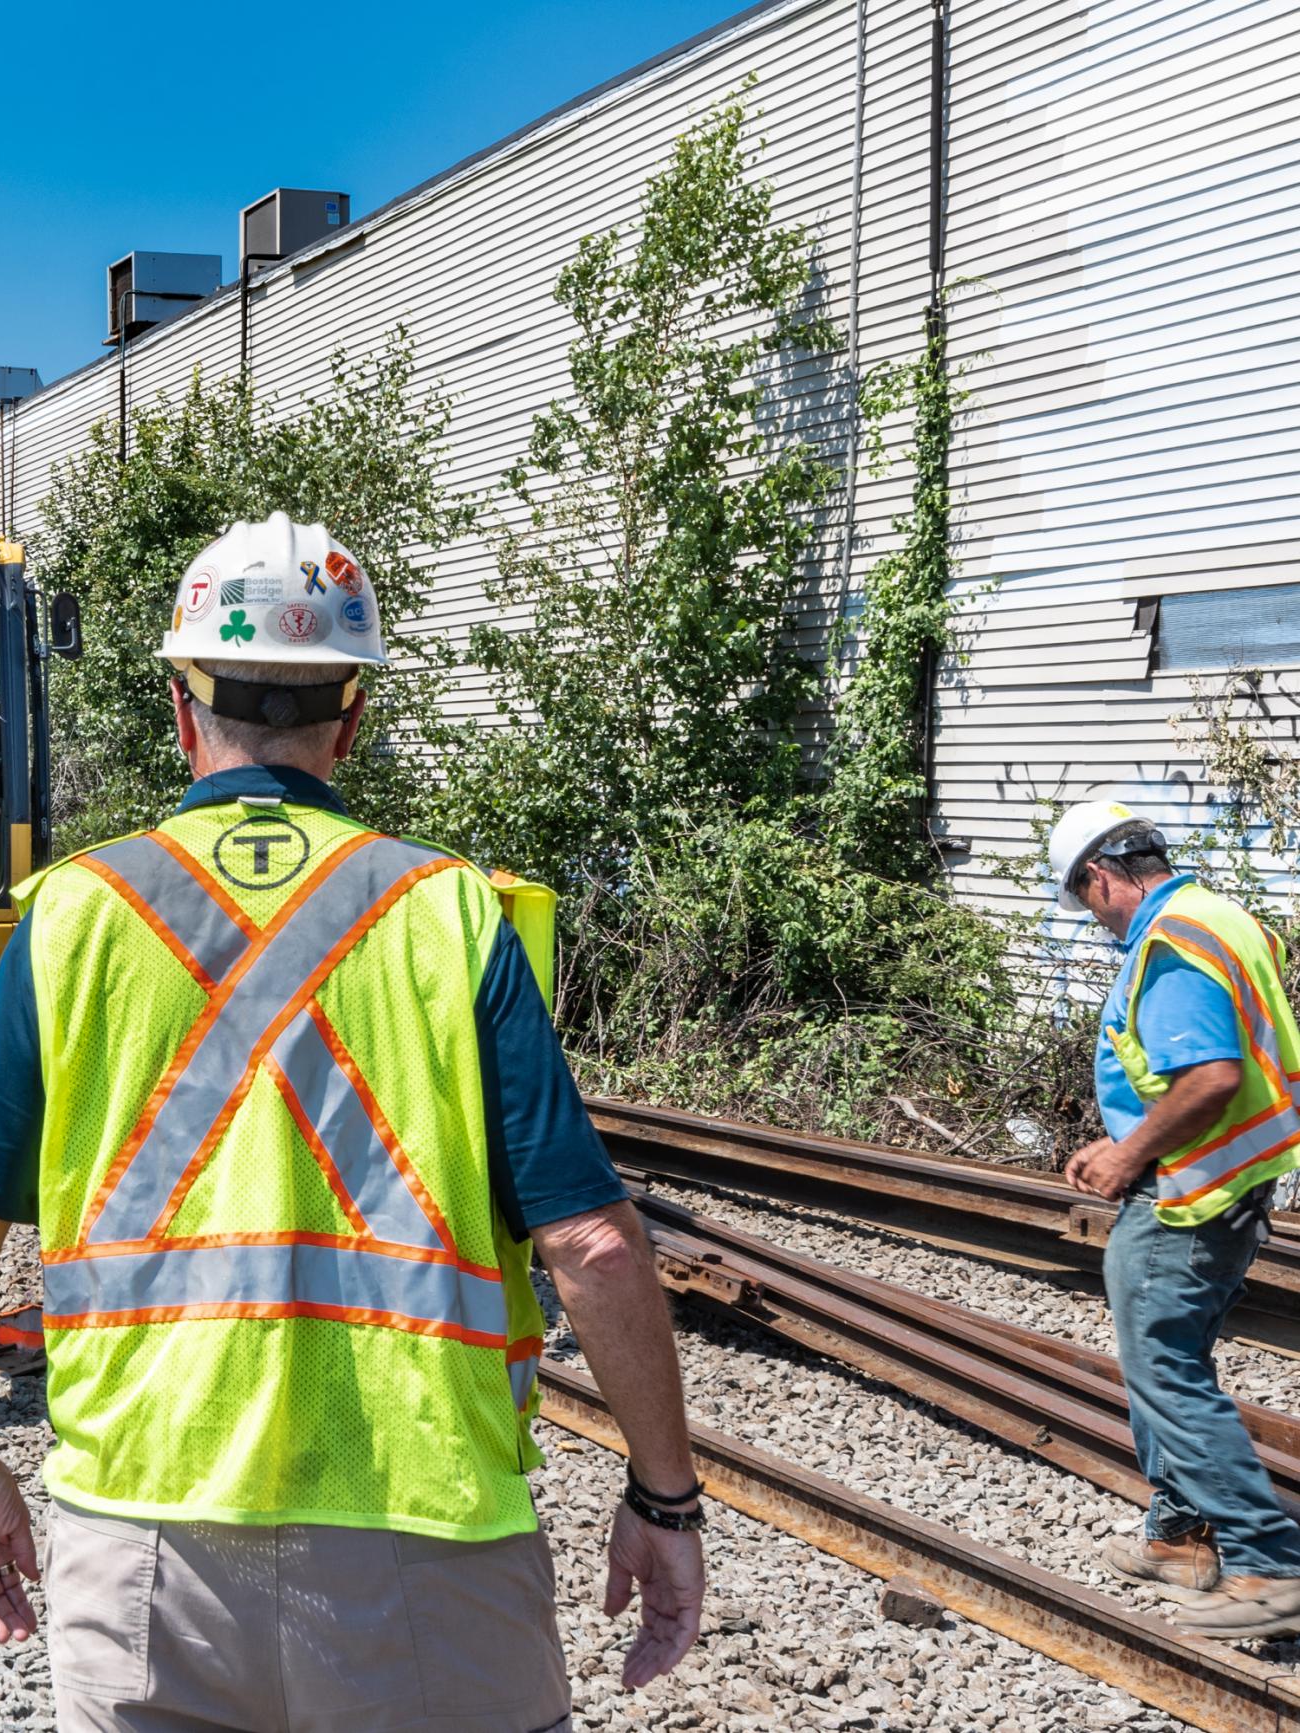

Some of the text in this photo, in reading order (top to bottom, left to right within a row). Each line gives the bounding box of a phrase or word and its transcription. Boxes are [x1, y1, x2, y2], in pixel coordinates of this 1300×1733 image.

[245, 577, 282, 585] Boston
[191, 583, 209, 605] T
[245, 586, 282, 597] Bridge
[232, 834, 291, 874] T
